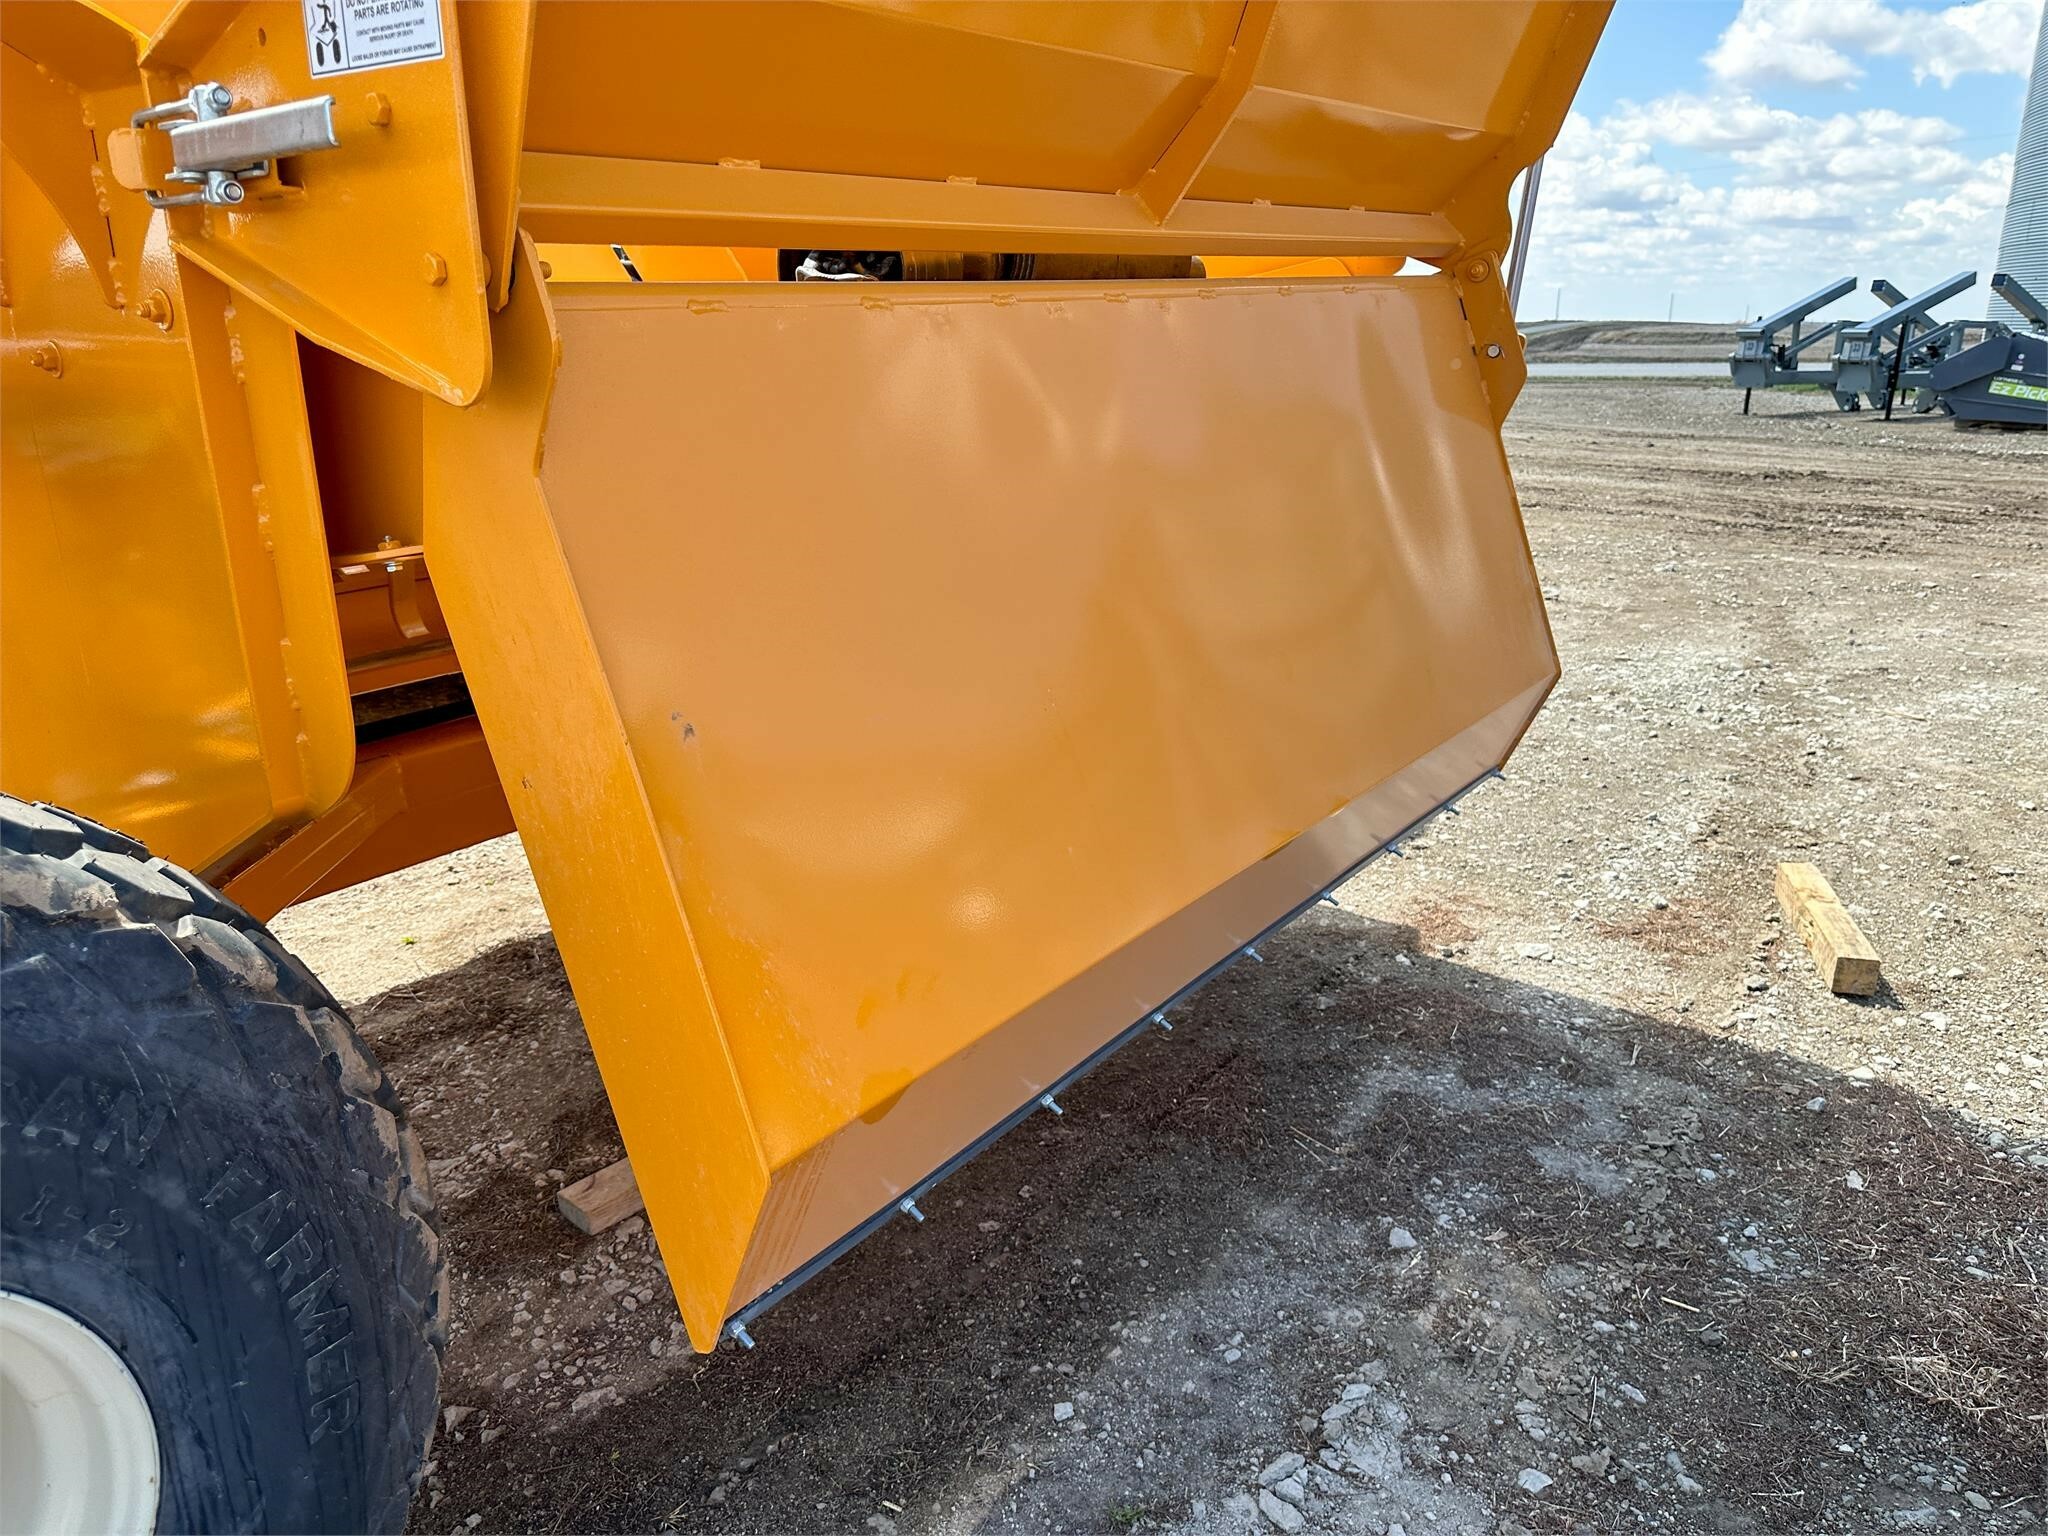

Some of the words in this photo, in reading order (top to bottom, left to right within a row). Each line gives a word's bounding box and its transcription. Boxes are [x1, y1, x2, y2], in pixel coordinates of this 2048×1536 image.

[345, 0, 355, 8] DO
[354, 6, 375, 20] PARTS
[376, 3, 389, 15] ARE
[390, 0, 424, 14] ROTATING
[380, 24, 393, 32] MOVING
[413, 17, 425, 26] CAUSE
[384, 32, 396, 40] INJURY
[363, 52, 374, 60] BALES
[401, 46, 413, 54] CAUSE
[199, 1149, 363, 1446] FARMER
